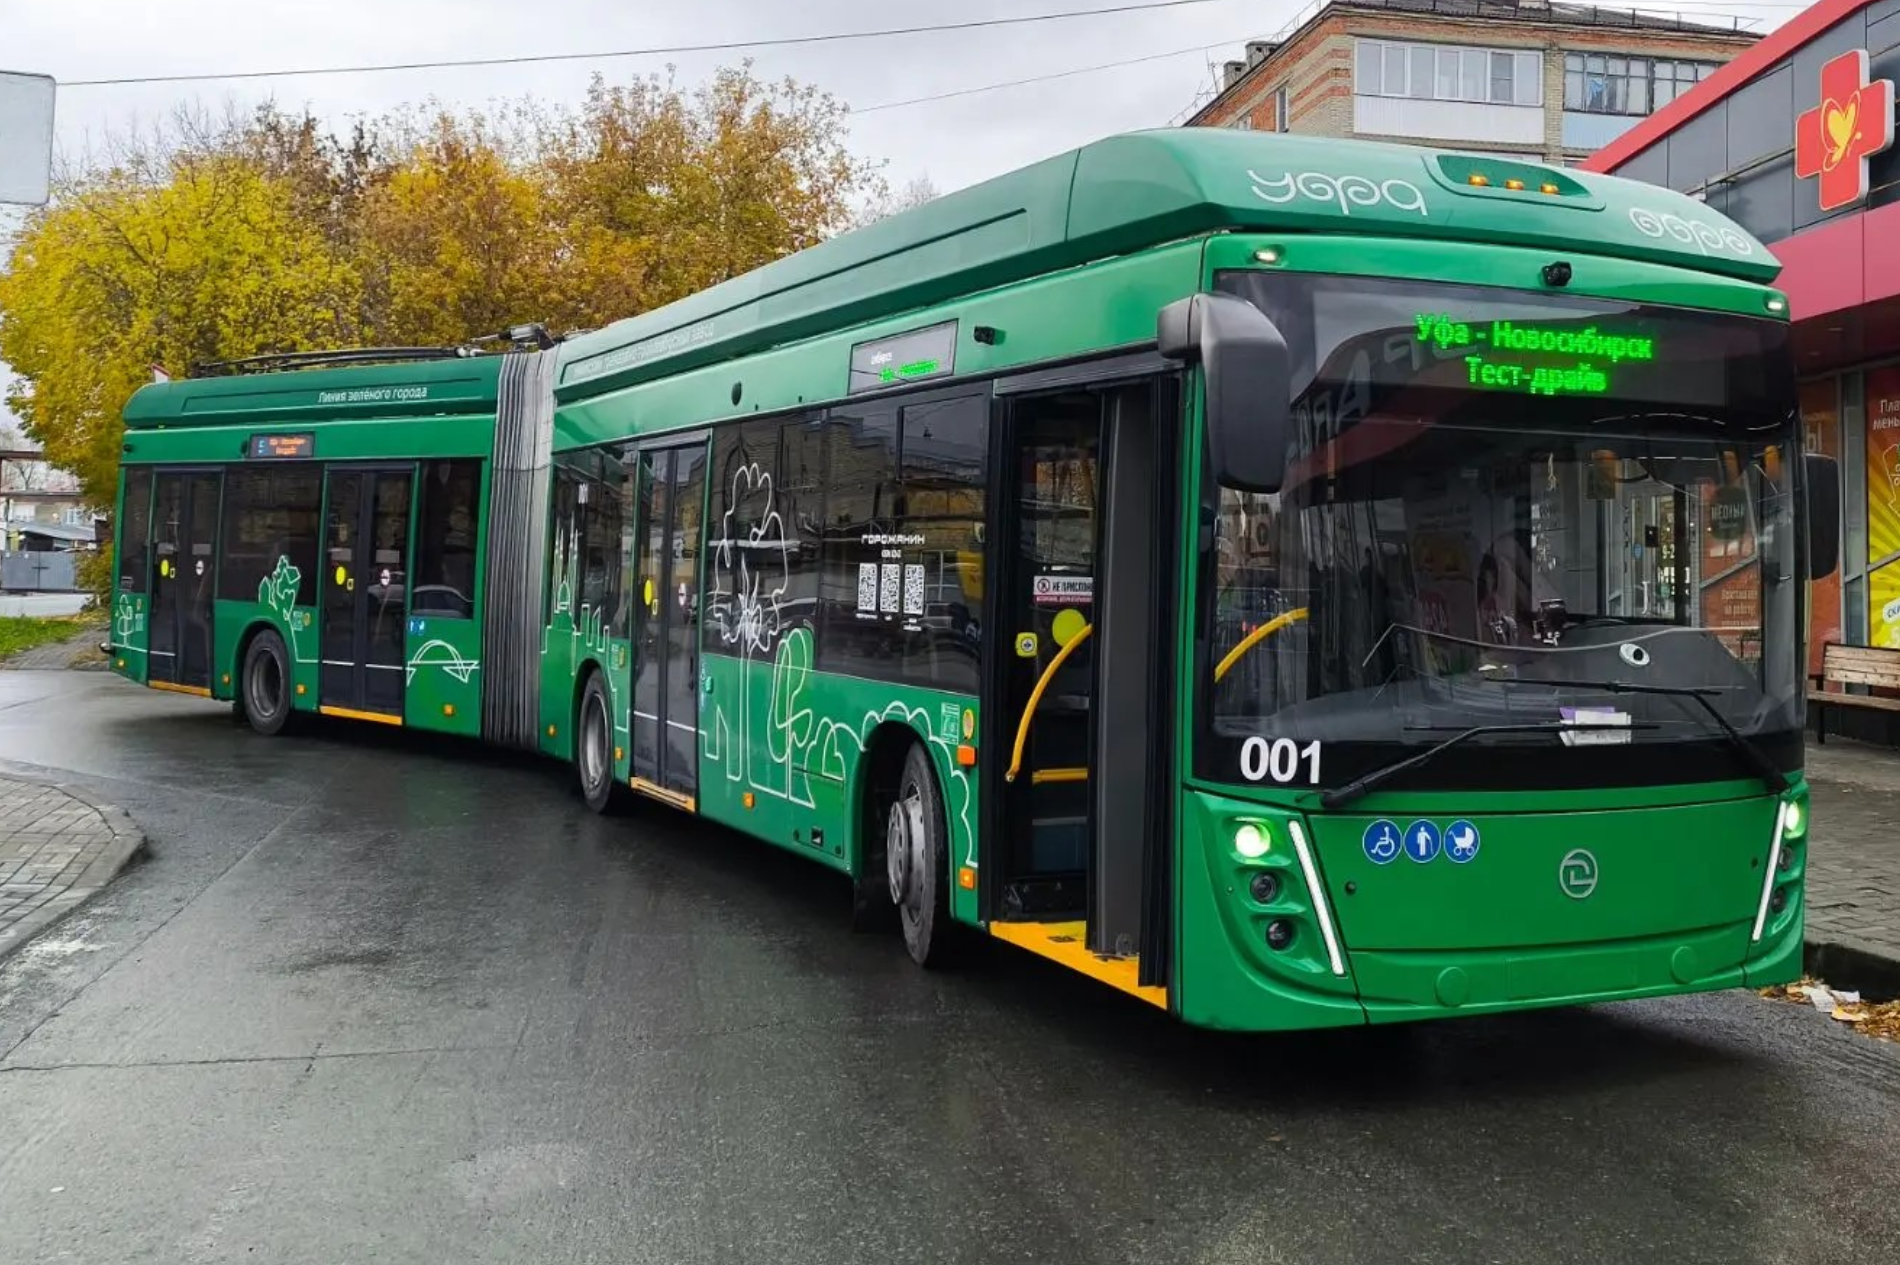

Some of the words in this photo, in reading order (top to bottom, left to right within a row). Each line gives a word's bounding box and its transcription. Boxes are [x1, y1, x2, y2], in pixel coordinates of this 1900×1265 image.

[1416, 313, 1470, 349] Уфа
[1493, 319, 1653, 363] Новосибирск
[318, 391, 346, 403] Линия
[392, 386, 428, 403] города
[1465, 353, 1607, 395] Тест-драйв
[861, 534, 925, 546] ГОРОЖАНИН
[1240, 736, 1321, 784] 001
